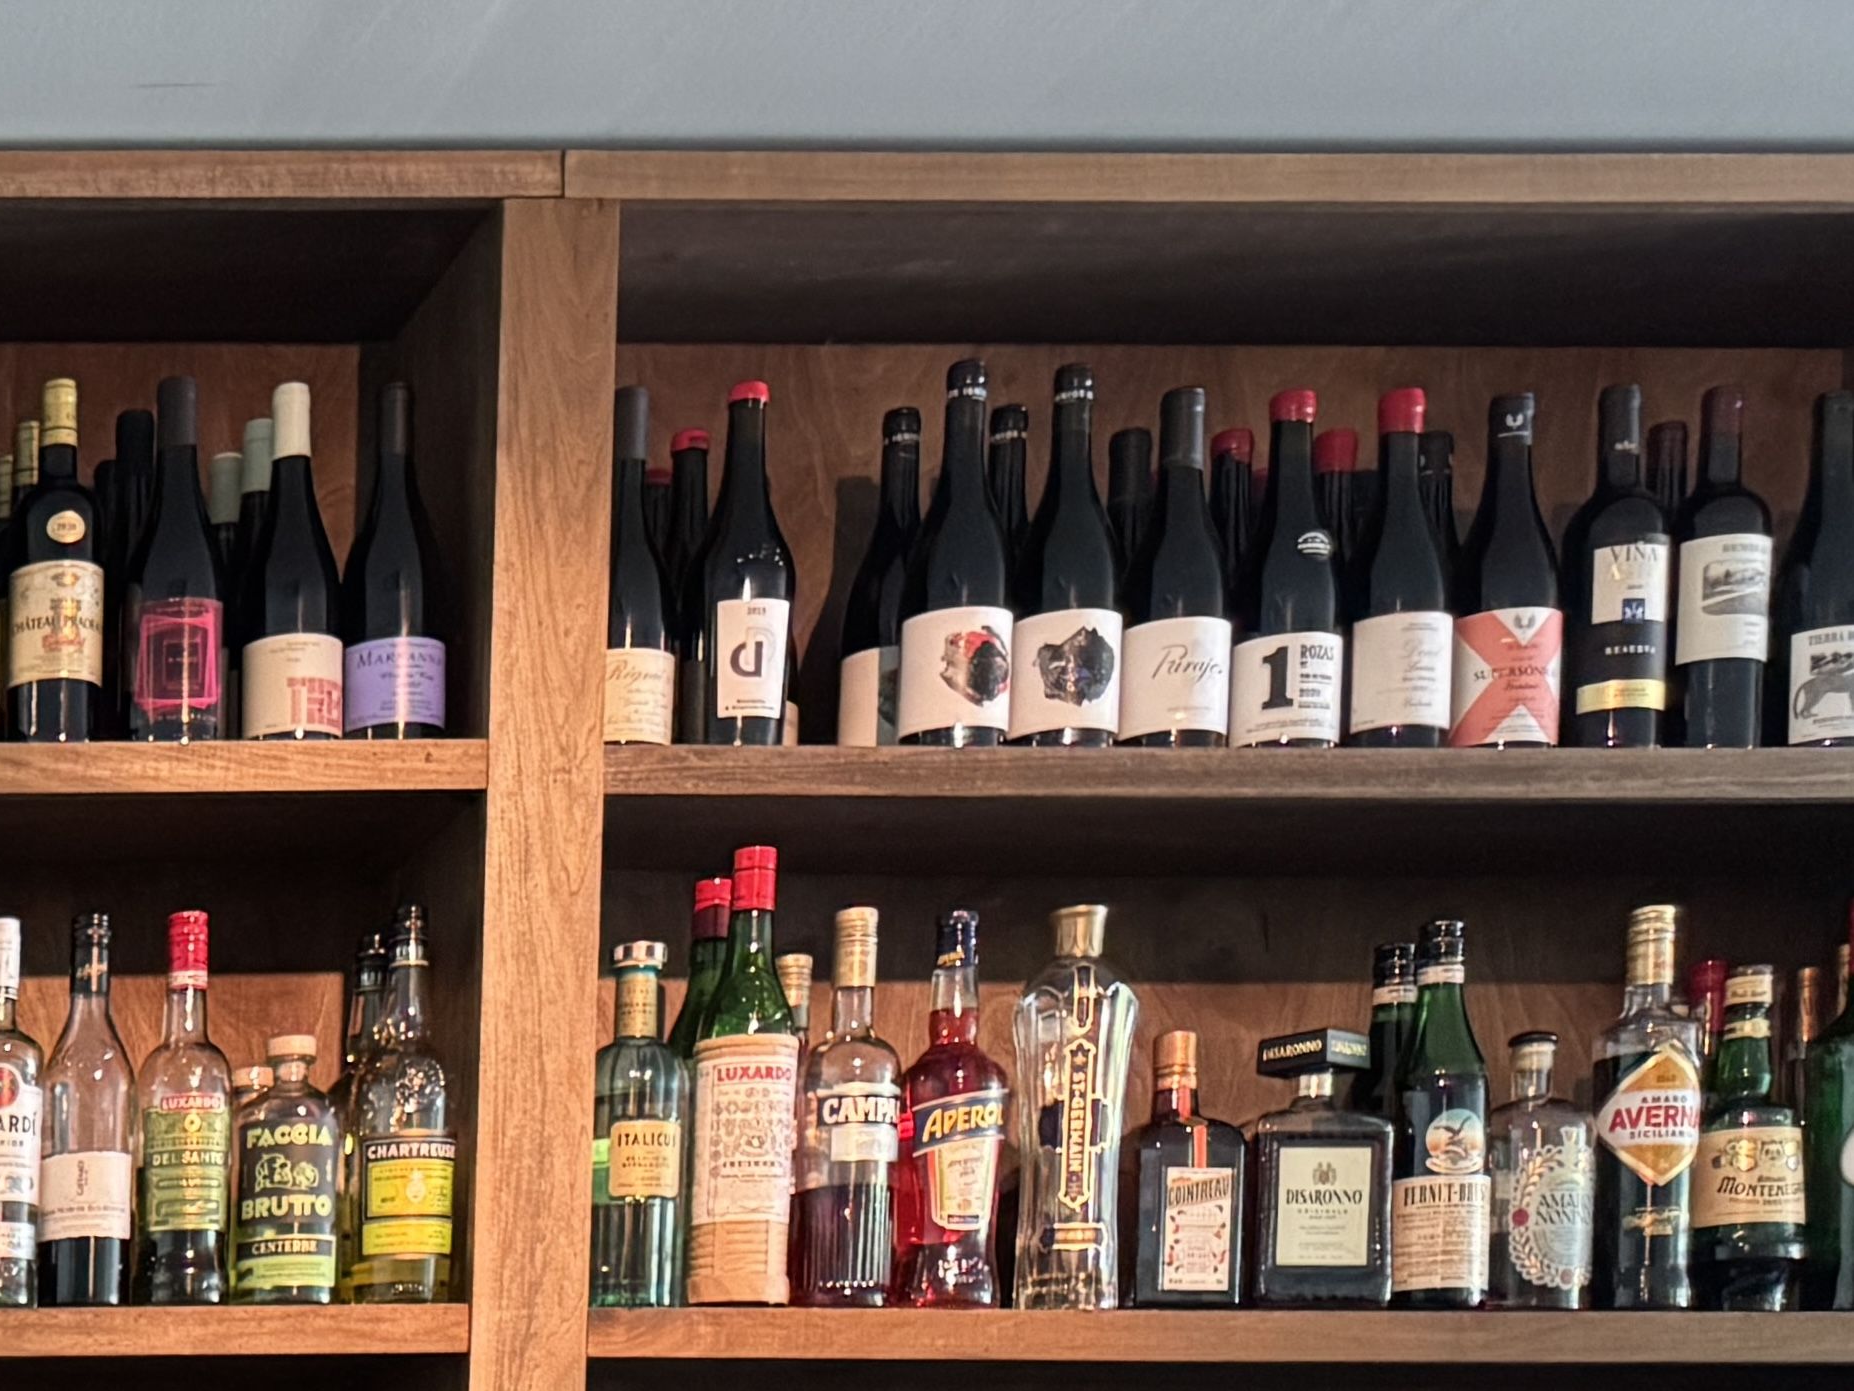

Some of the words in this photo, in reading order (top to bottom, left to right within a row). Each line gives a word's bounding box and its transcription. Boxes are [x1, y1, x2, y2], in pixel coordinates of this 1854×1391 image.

[1262, 1039, 1323, 1061] DISARONNO
[716, 1063, 792, 1083] LUXARDO
[162, 1096, 221, 1110] LUXARDO
[822, 1096, 900, 1124] CAMPA
[922, 1101, 1005, 1142] APEROL
[1609, 1106, 1700, 1133] AVERNA
[246, 1123, 333, 1148] FACCIA
[152, 1153, 176, 1166] DEL
[367, 1142, 456, 1160] CHARTREUSE
[1168, 1172, 1230, 1207] COINTREAU
[1285, 1189, 1364, 1206] DISARONNO
[242, 1194, 333, 1220] BRUTTO
